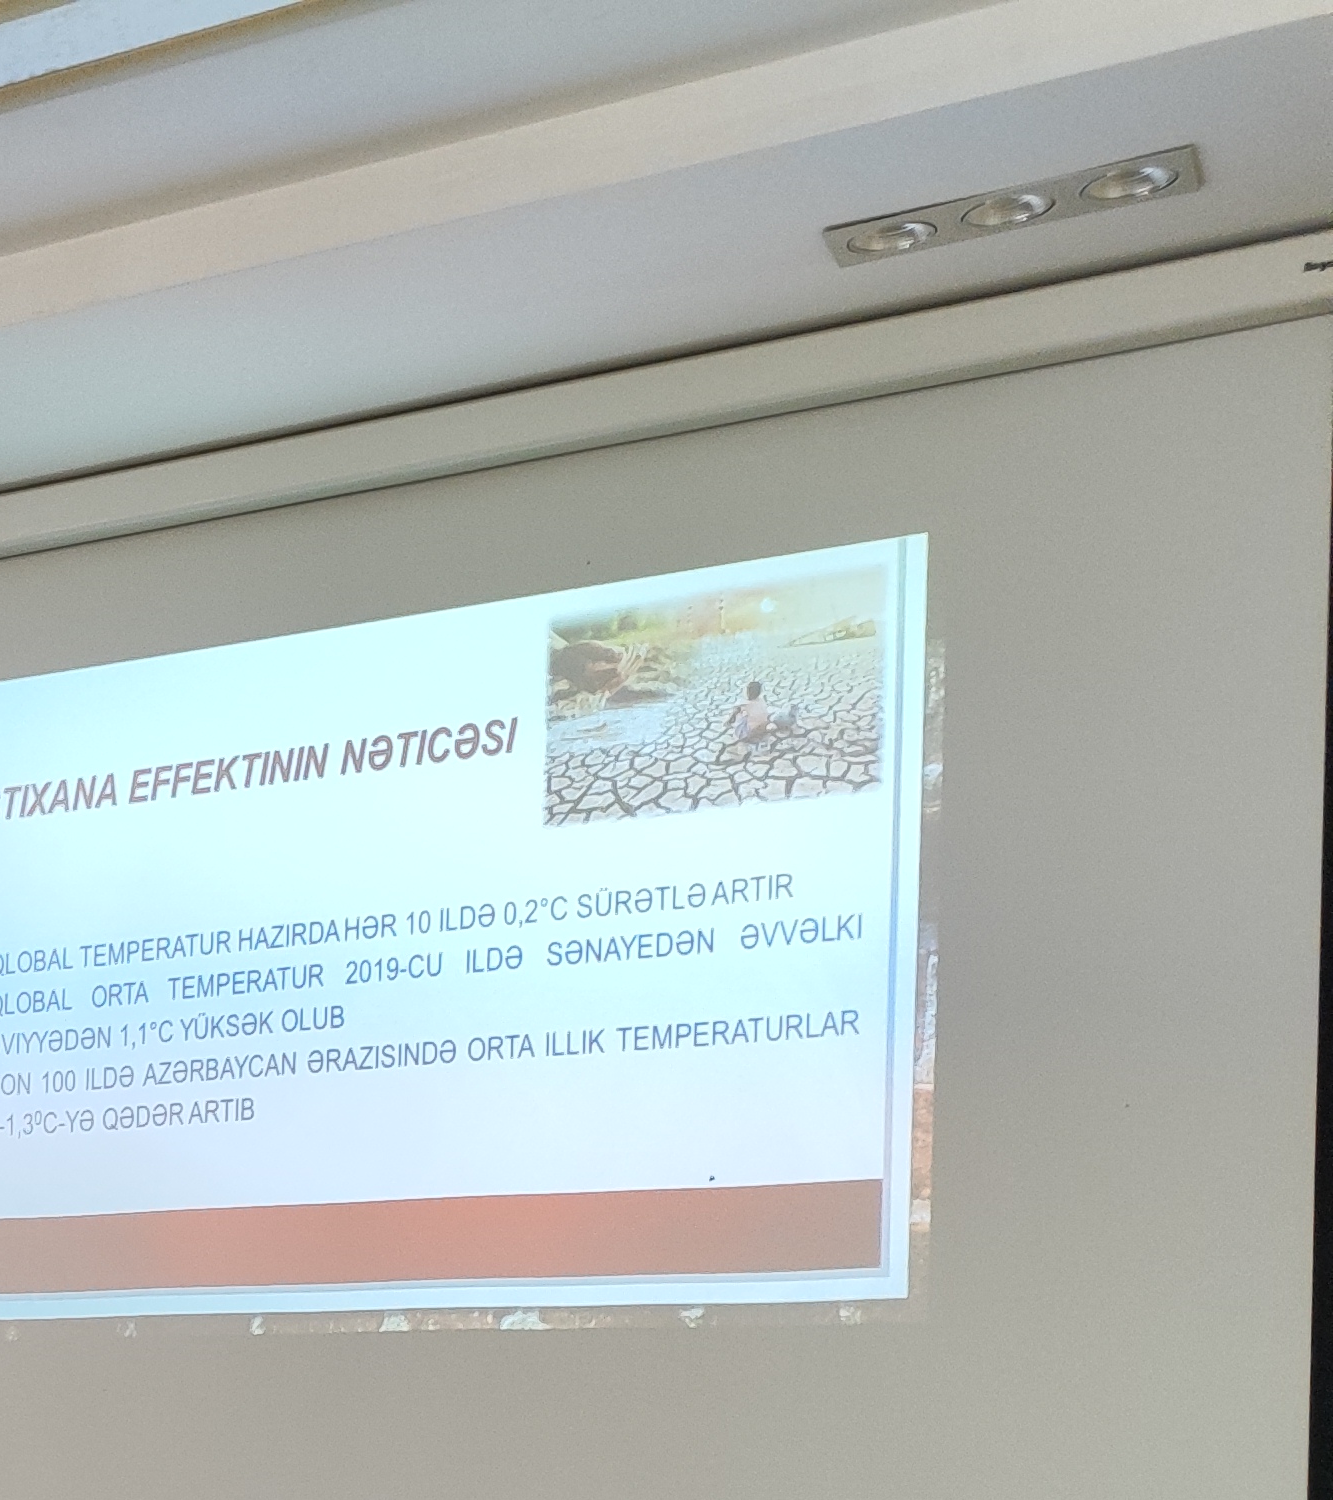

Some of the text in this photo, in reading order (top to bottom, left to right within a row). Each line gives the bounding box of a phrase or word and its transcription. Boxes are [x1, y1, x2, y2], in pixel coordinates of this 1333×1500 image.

[129, 742, 329, 804] EFFEKTININ
[341, 717, 518, 775] NƏTICƏSI
[80, 930, 230, 968] TEMPERATUR
[239, 920, 340, 956] HAZIRDA
[345, 914, 397, 943] HƏR
[406, 910, 431, 935] 10
[439, 904, 495, 932] ILDƏ
[577, 884, 706, 919] SÜRƏTLƏ
[711, 874, 793, 905] ARTIR
[92, 981, 148, 1008] ORTA
[168, 964, 324, 1001] TEMPERATUR
[345, 952, 442, 985] 2019-CU
[466, 945, 523, 974] ILDƏ
[547, 928, 715, 966] SƏNAYEDƏN
[740, 913, 863, 949] ƏVVƏLKI
[41, 1070, 76, 1094] 100
[85, 1065, 134, 1091] ILDƏ
[143, 1052, 296, 1087] AZƏRBAYCAN
[307, 1040, 456, 1074] ƏRAZISINDƏ
[468, 1034, 535, 1062] ORTA
[545, 1028, 605, 1056] ILLIK
[616, 1009, 860, 1053] TEMPERATURLAR
[180, 1011, 274, 1042] YÜKSƏK
[281, 1005, 345, 1033] OLUB
[103, 1101, 184, 1131] QƏDƏR
[188, 1097, 255, 1124] ARTIB
